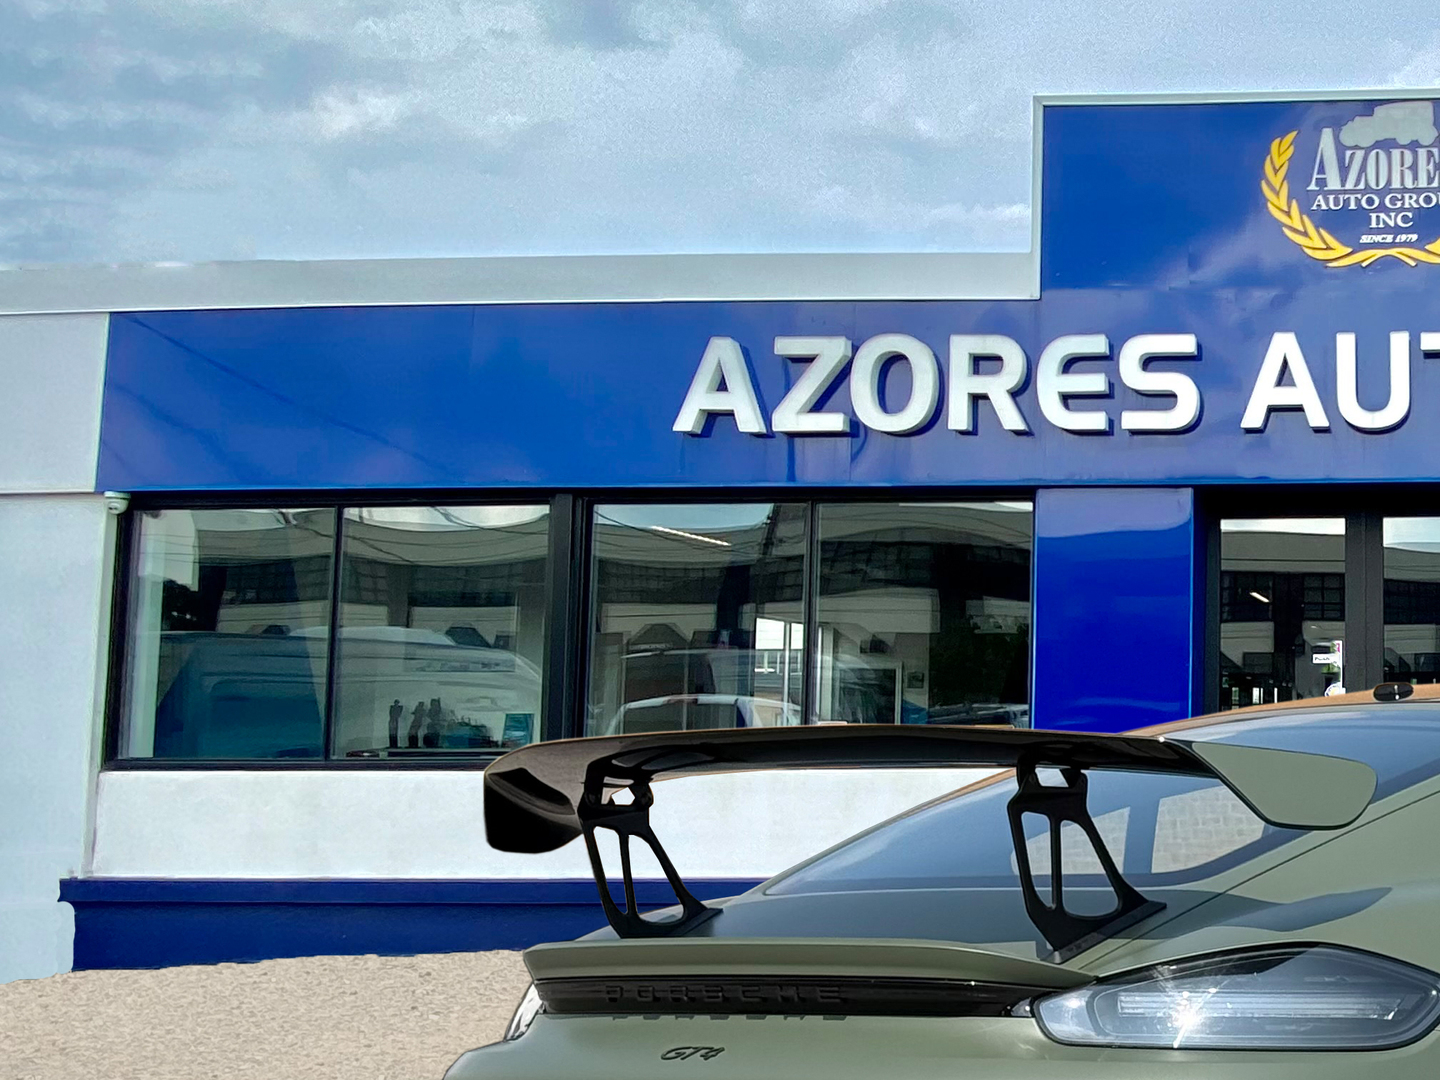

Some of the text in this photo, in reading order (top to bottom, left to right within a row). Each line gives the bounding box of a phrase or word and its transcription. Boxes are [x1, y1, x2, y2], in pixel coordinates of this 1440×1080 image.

[1310, 193, 1380, 211] AUTO
[1369, 212, 1414, 228] INC
[1359, 233, 1418, 244] SINCE 1979
[672, 333, 1201, 436] AZORES
[605, 984, 842, 1003] PORSCHE
[660, 1046, 725, 1061] GT4
